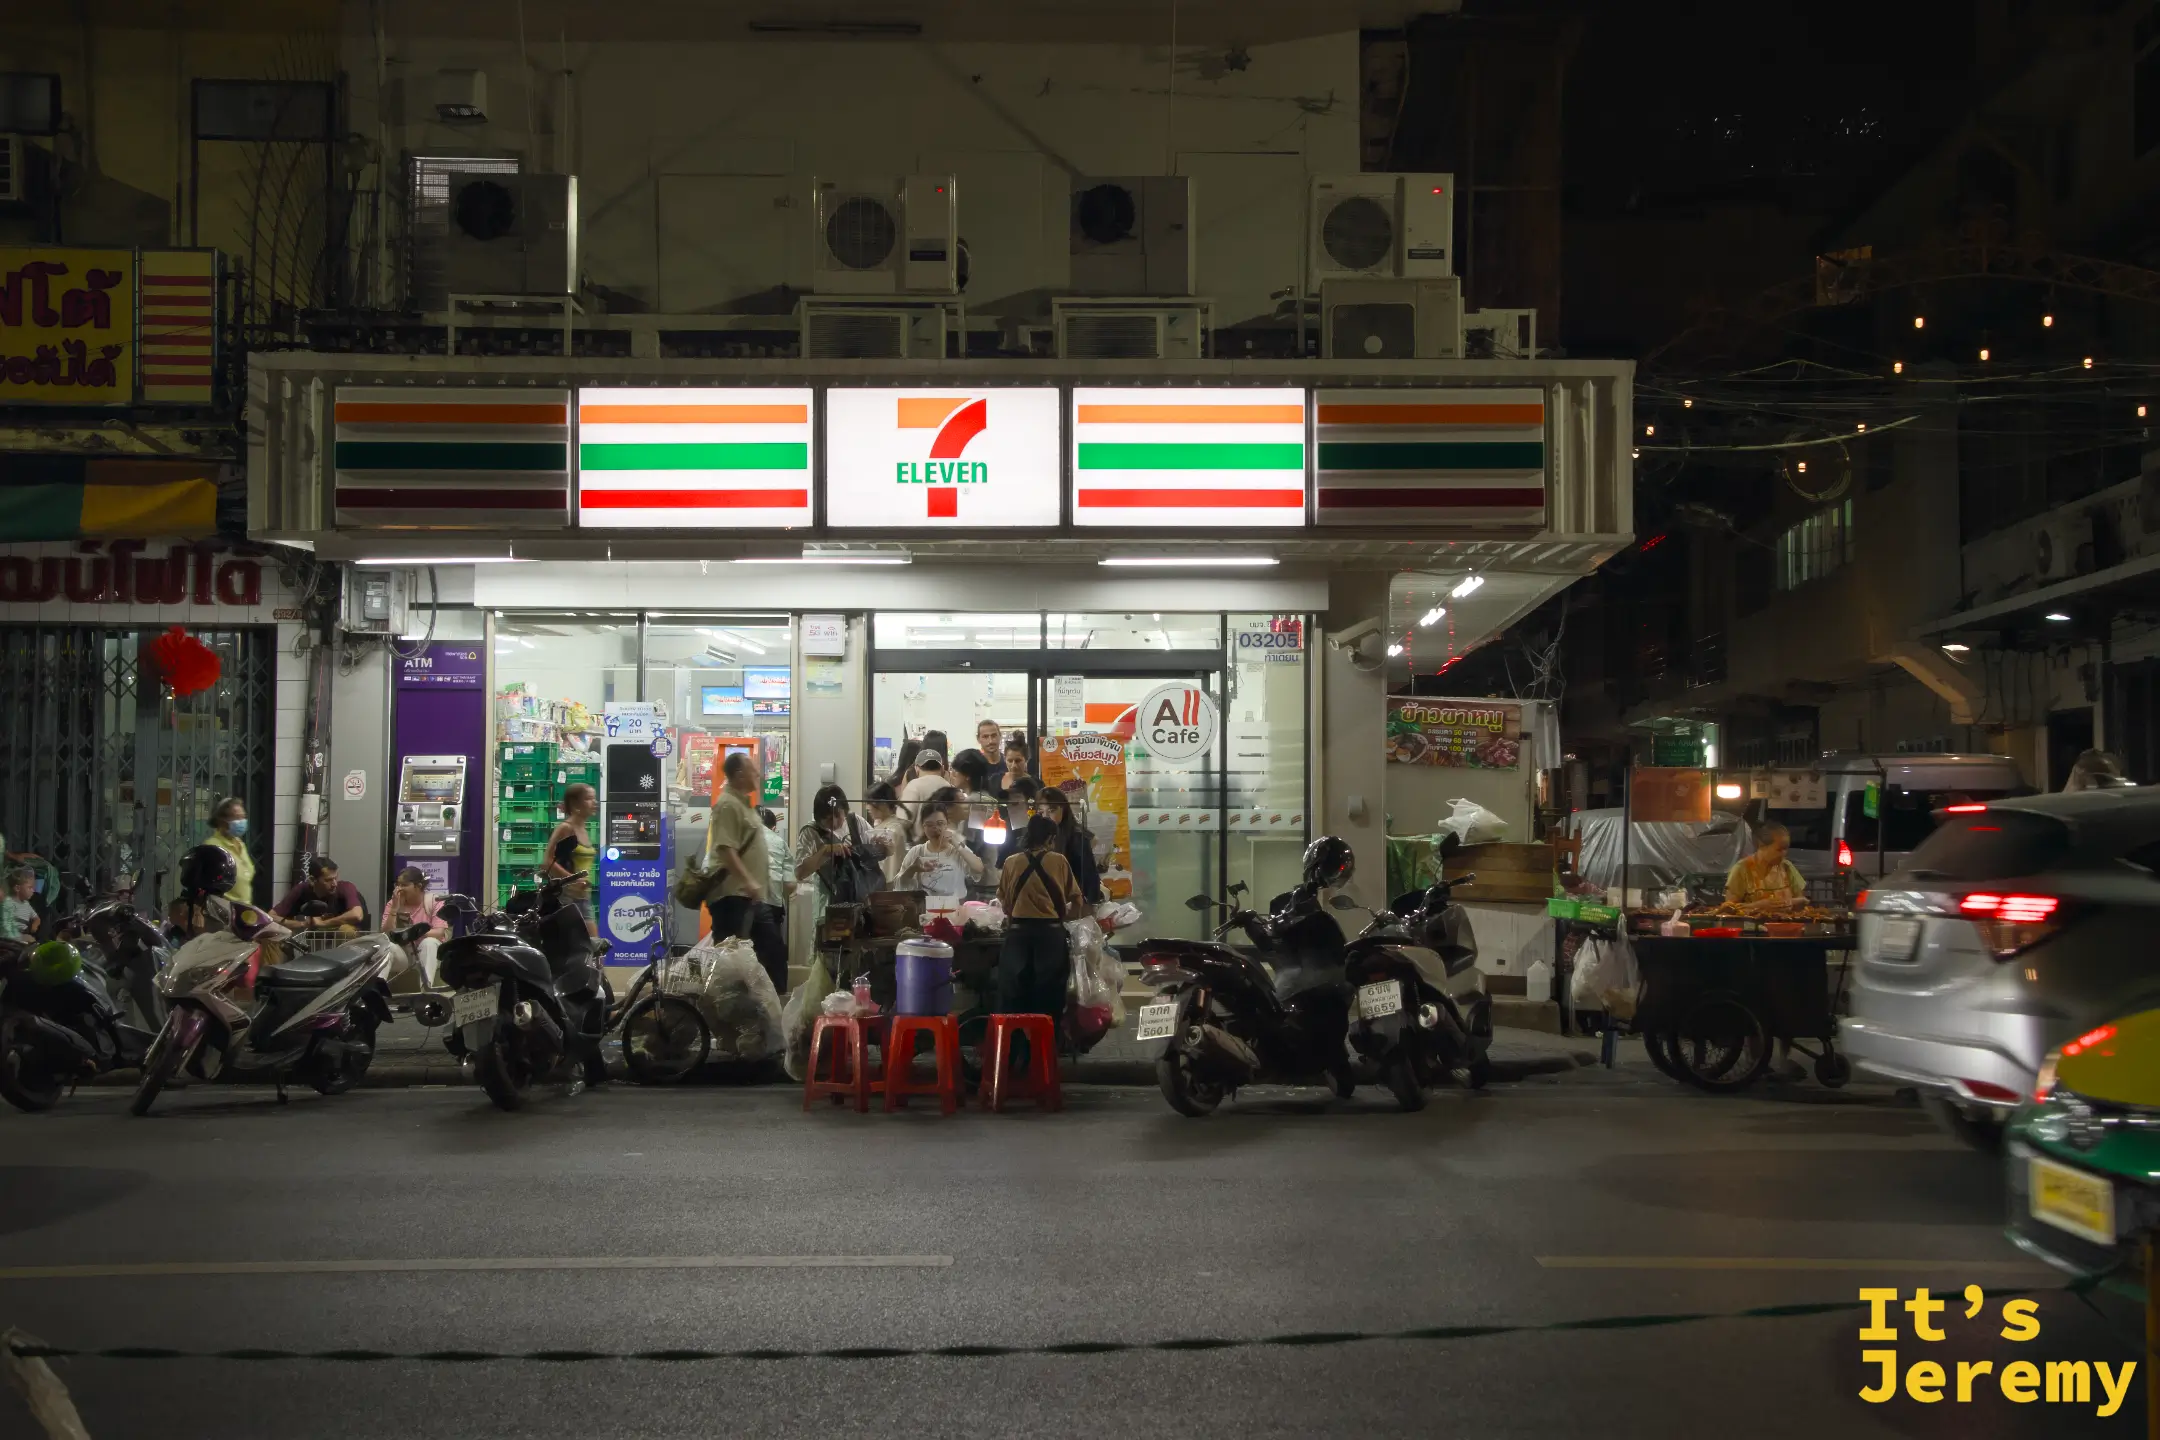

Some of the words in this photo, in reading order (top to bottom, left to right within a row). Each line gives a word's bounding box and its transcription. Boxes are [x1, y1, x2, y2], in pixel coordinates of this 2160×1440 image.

[897, 397, 987, 517] 7
[1239, 633, 1298, 648] 03205
[404, 657, 433, 668] ATM
[1152, 689, 1201, 727] All
[628, 718, 642, 728] 20
[1401, 701, 1504, 732] ข้าวขาหมู
[1152, 726, 1200, 744] Café
[1143, 1025, 1169, 1037] 5601
